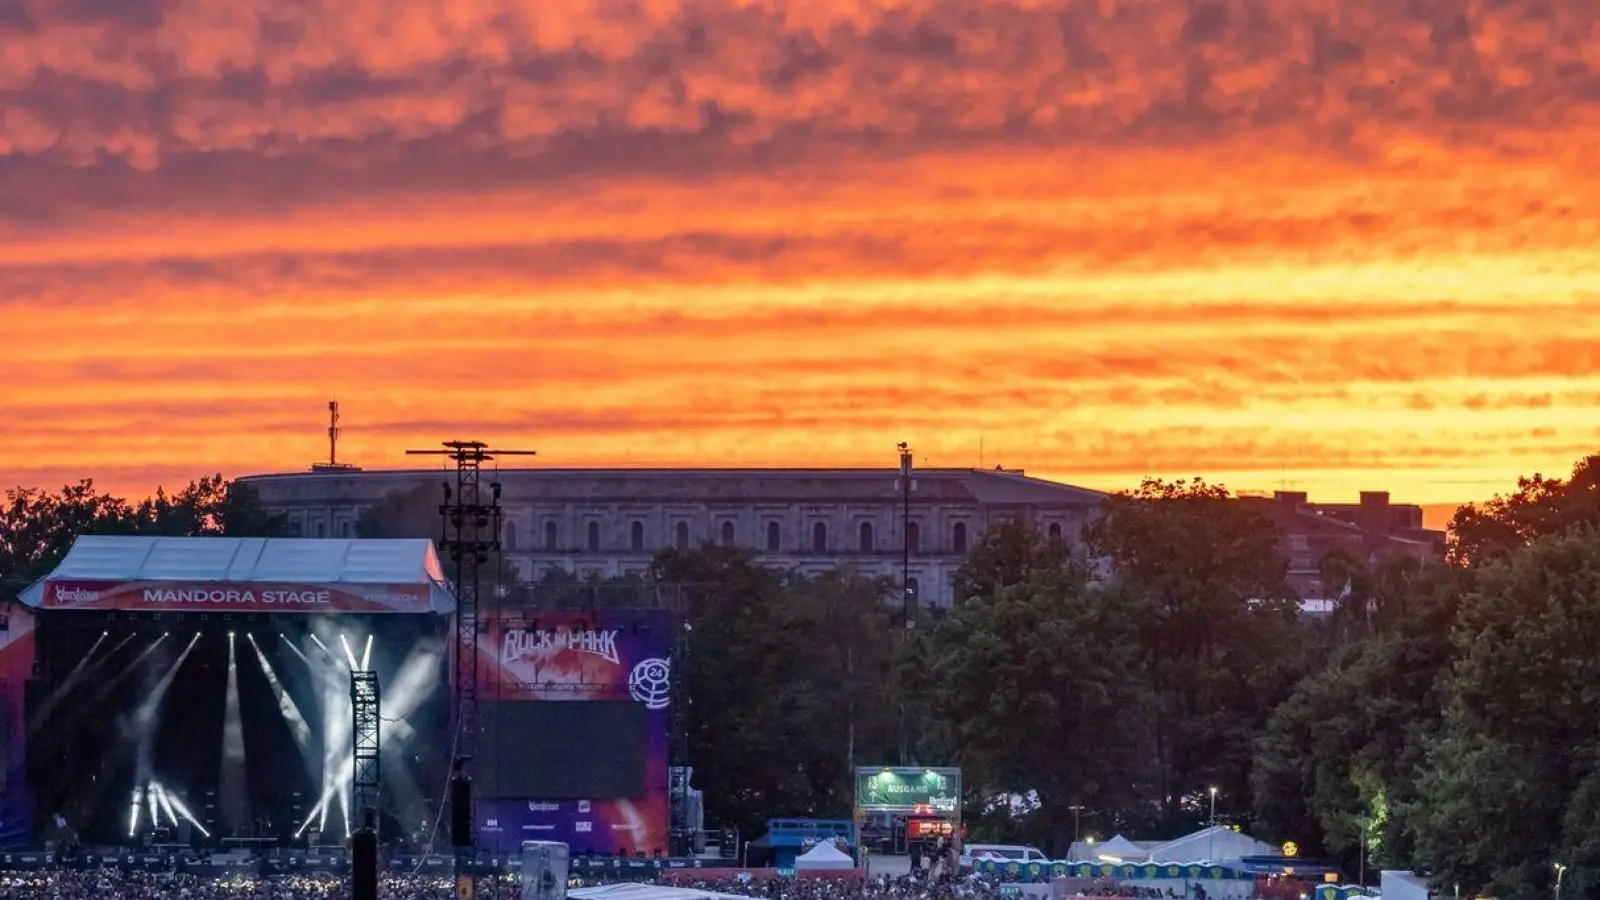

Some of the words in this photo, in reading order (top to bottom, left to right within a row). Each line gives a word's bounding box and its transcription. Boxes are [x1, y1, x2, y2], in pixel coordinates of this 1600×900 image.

[143, 589, 255, 603] MANDORA
[262, 590, 331, 603] STAGE
[502, 629, 551, 663] ROCK
[568, 629, 620, 665] PARK
[649, 667, 662, 678] 24
[887, 784, 929, 793] AUSGANG
